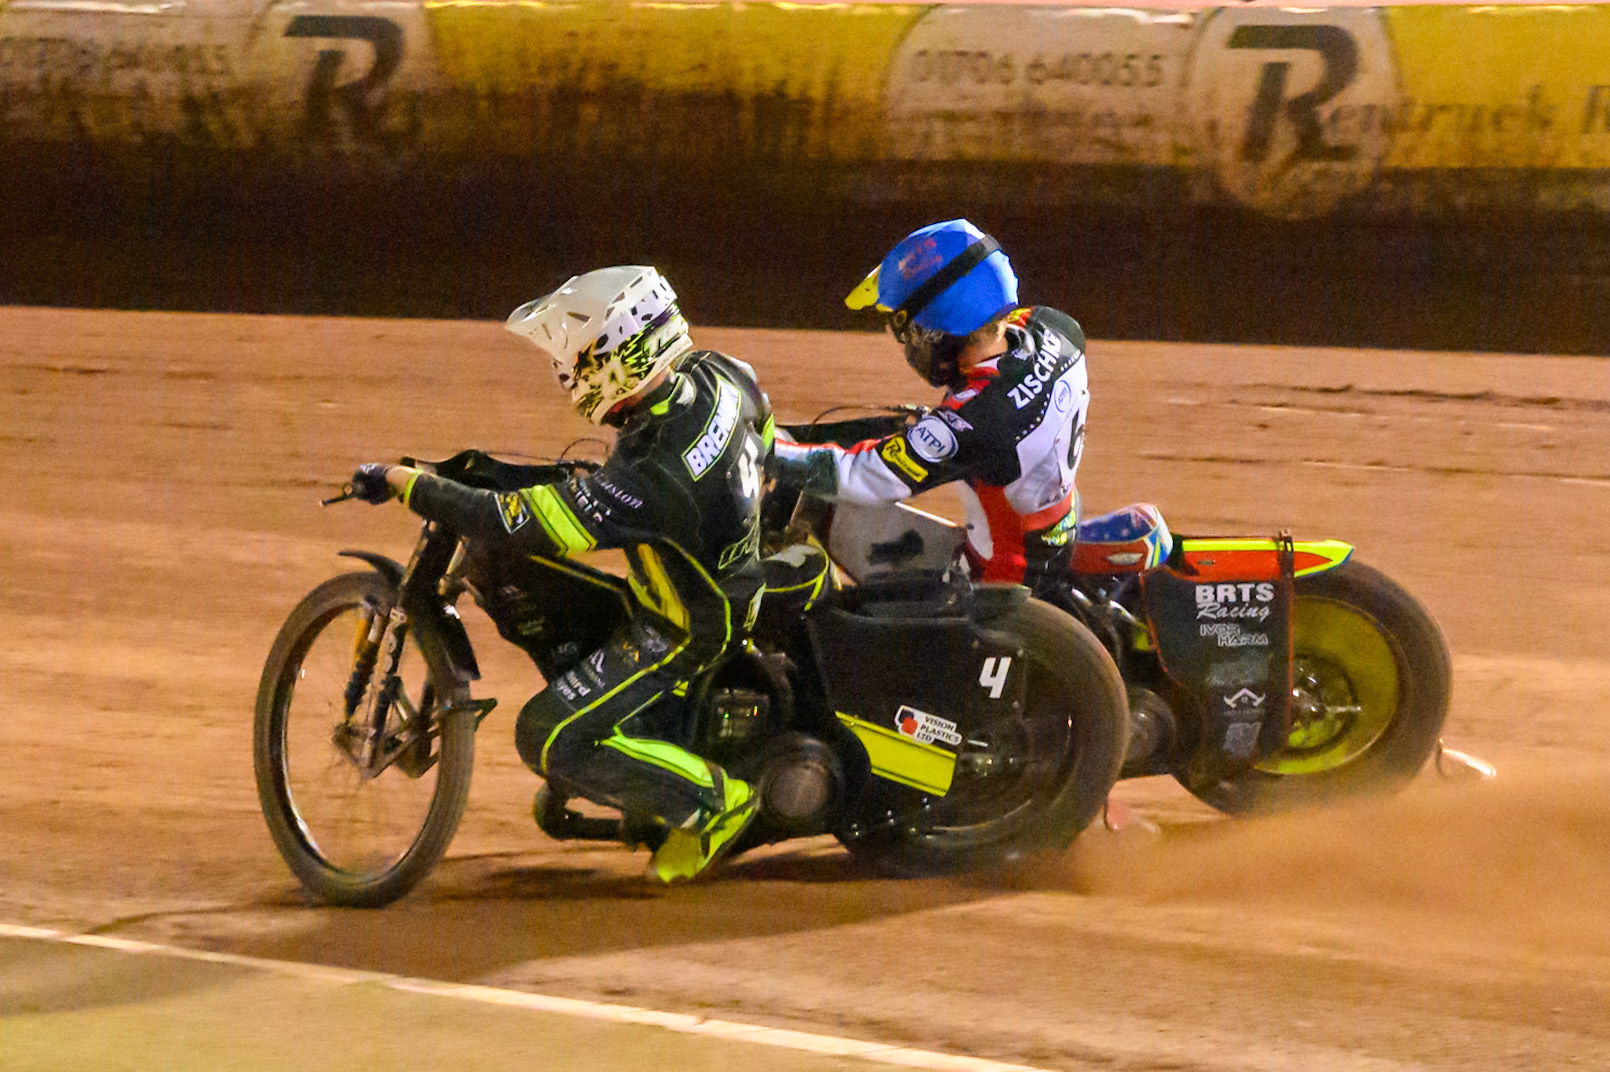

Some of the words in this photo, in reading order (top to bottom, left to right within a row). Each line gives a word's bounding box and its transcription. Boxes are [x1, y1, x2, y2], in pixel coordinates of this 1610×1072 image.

[914, 427, 946, 453] ATPI
[1195, 583, 1275, 603] BRTS
[1196, 601, 1272, 623] Racing
[979, 657, 1012, 698] 4
[920, 724, 960, 742] PLASTICS
[925, 716, 955, 731] VISION
[916, 732, 932, 742] LTD
